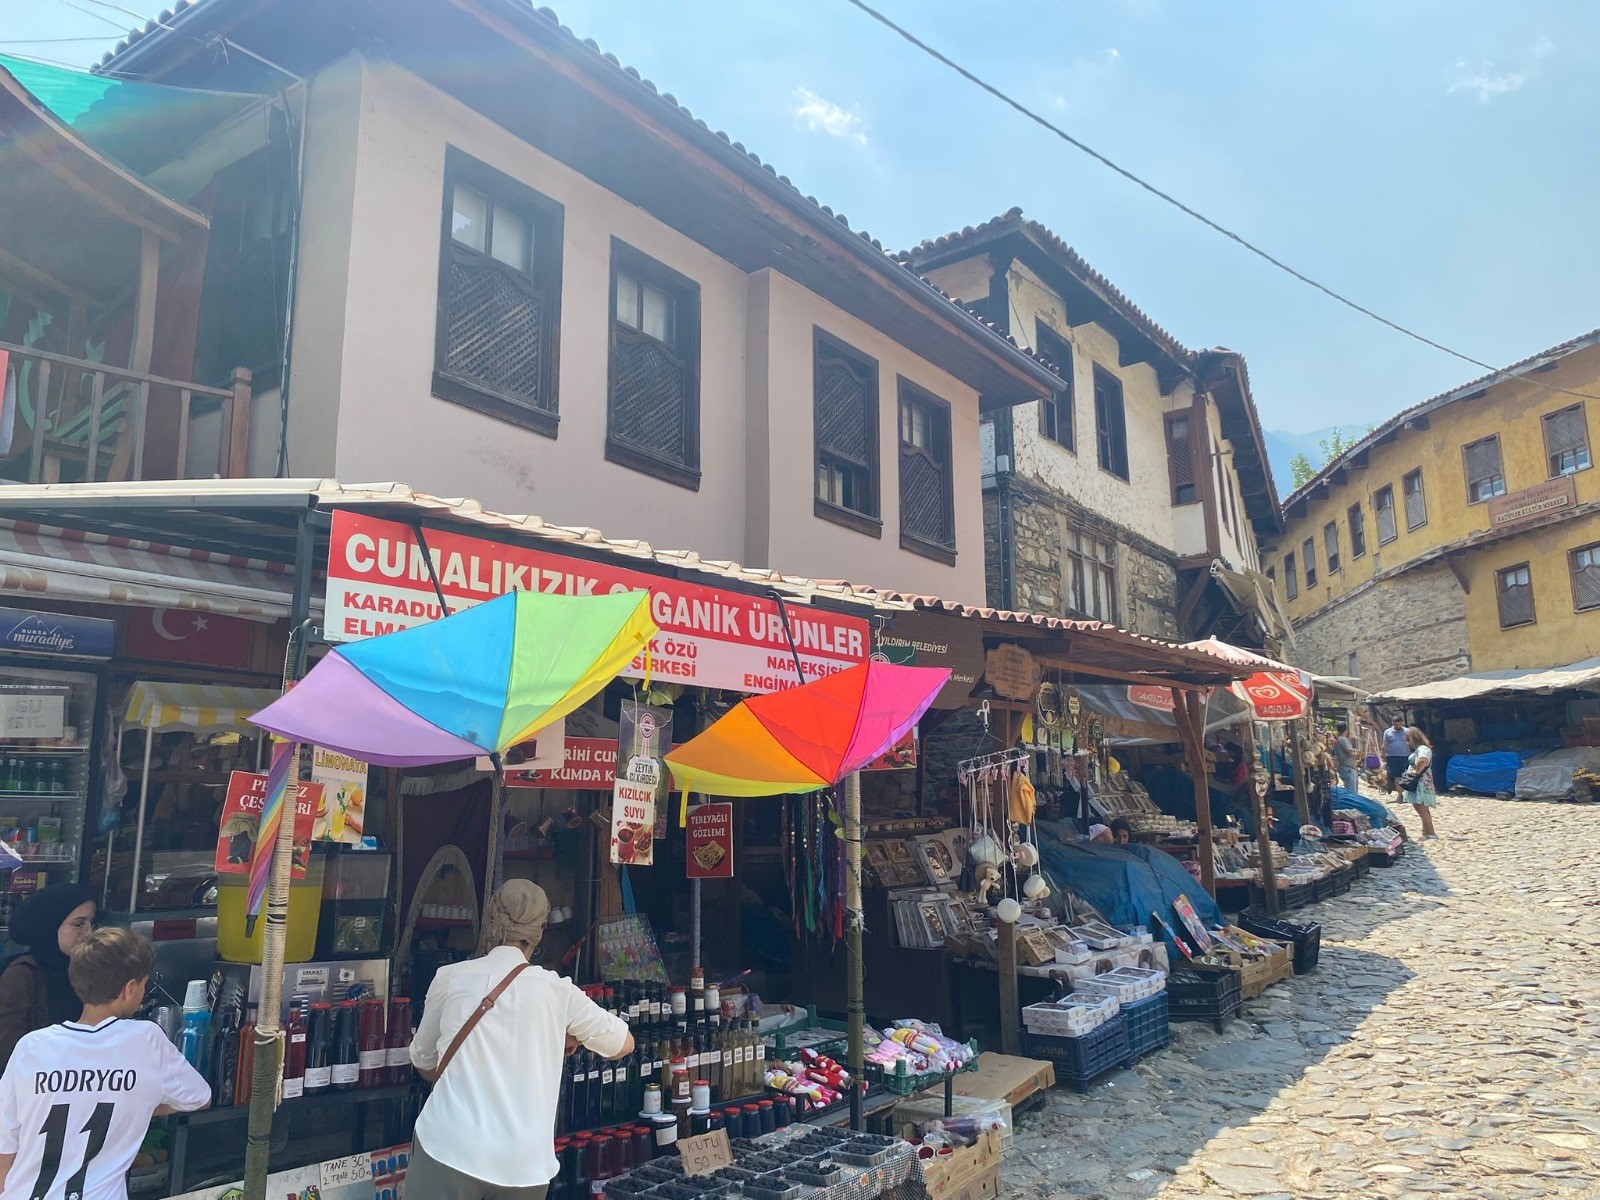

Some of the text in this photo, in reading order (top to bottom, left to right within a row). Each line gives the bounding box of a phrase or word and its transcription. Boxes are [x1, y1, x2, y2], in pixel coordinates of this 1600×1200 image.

[345, 533, 863, 657] CUMALIKIZIK GANİK ÜRÜNLER
[14, 630, 74, 651] muradiye
[22, 628, 48, 636] BURSA
[881, 634, 949, 655] YILDIRIM BELEDİYESİ
[664, 637, 697, 659] ÖZÜ
[767, 655, 796, 672] NAR
[631, 653, 697, 678] SİRKESİ
[744, 673, 805, 691] ENGİNA
[953, 673, 975, 684] Merkezi
[314, 752, 367, 775] LİMONATA
[550, 767, 601, 781] KUMDA
[619, 787, 652, 803] KIZILCIK
[624, 805, 645, 820] SUYU
[690, 812, 728, 825] TEREYAĞLI
[692, 825, 726, 838] GÖZLEME
[35, 1069, 137, 1095] RODRYGO
[29, 1102, 115, 1200] 11
[687, 1137, 720, 1154] KUTU
[323, 1156, 349, 1173] TANE
[350, 1154, 365, 1168] 30
[694, 1155, 710, 1172] 50
[322, 1176, 329, 1186] 2
[331, 1171, 349, 1184] TANE
[350, 1168, 366, 1181] 50
